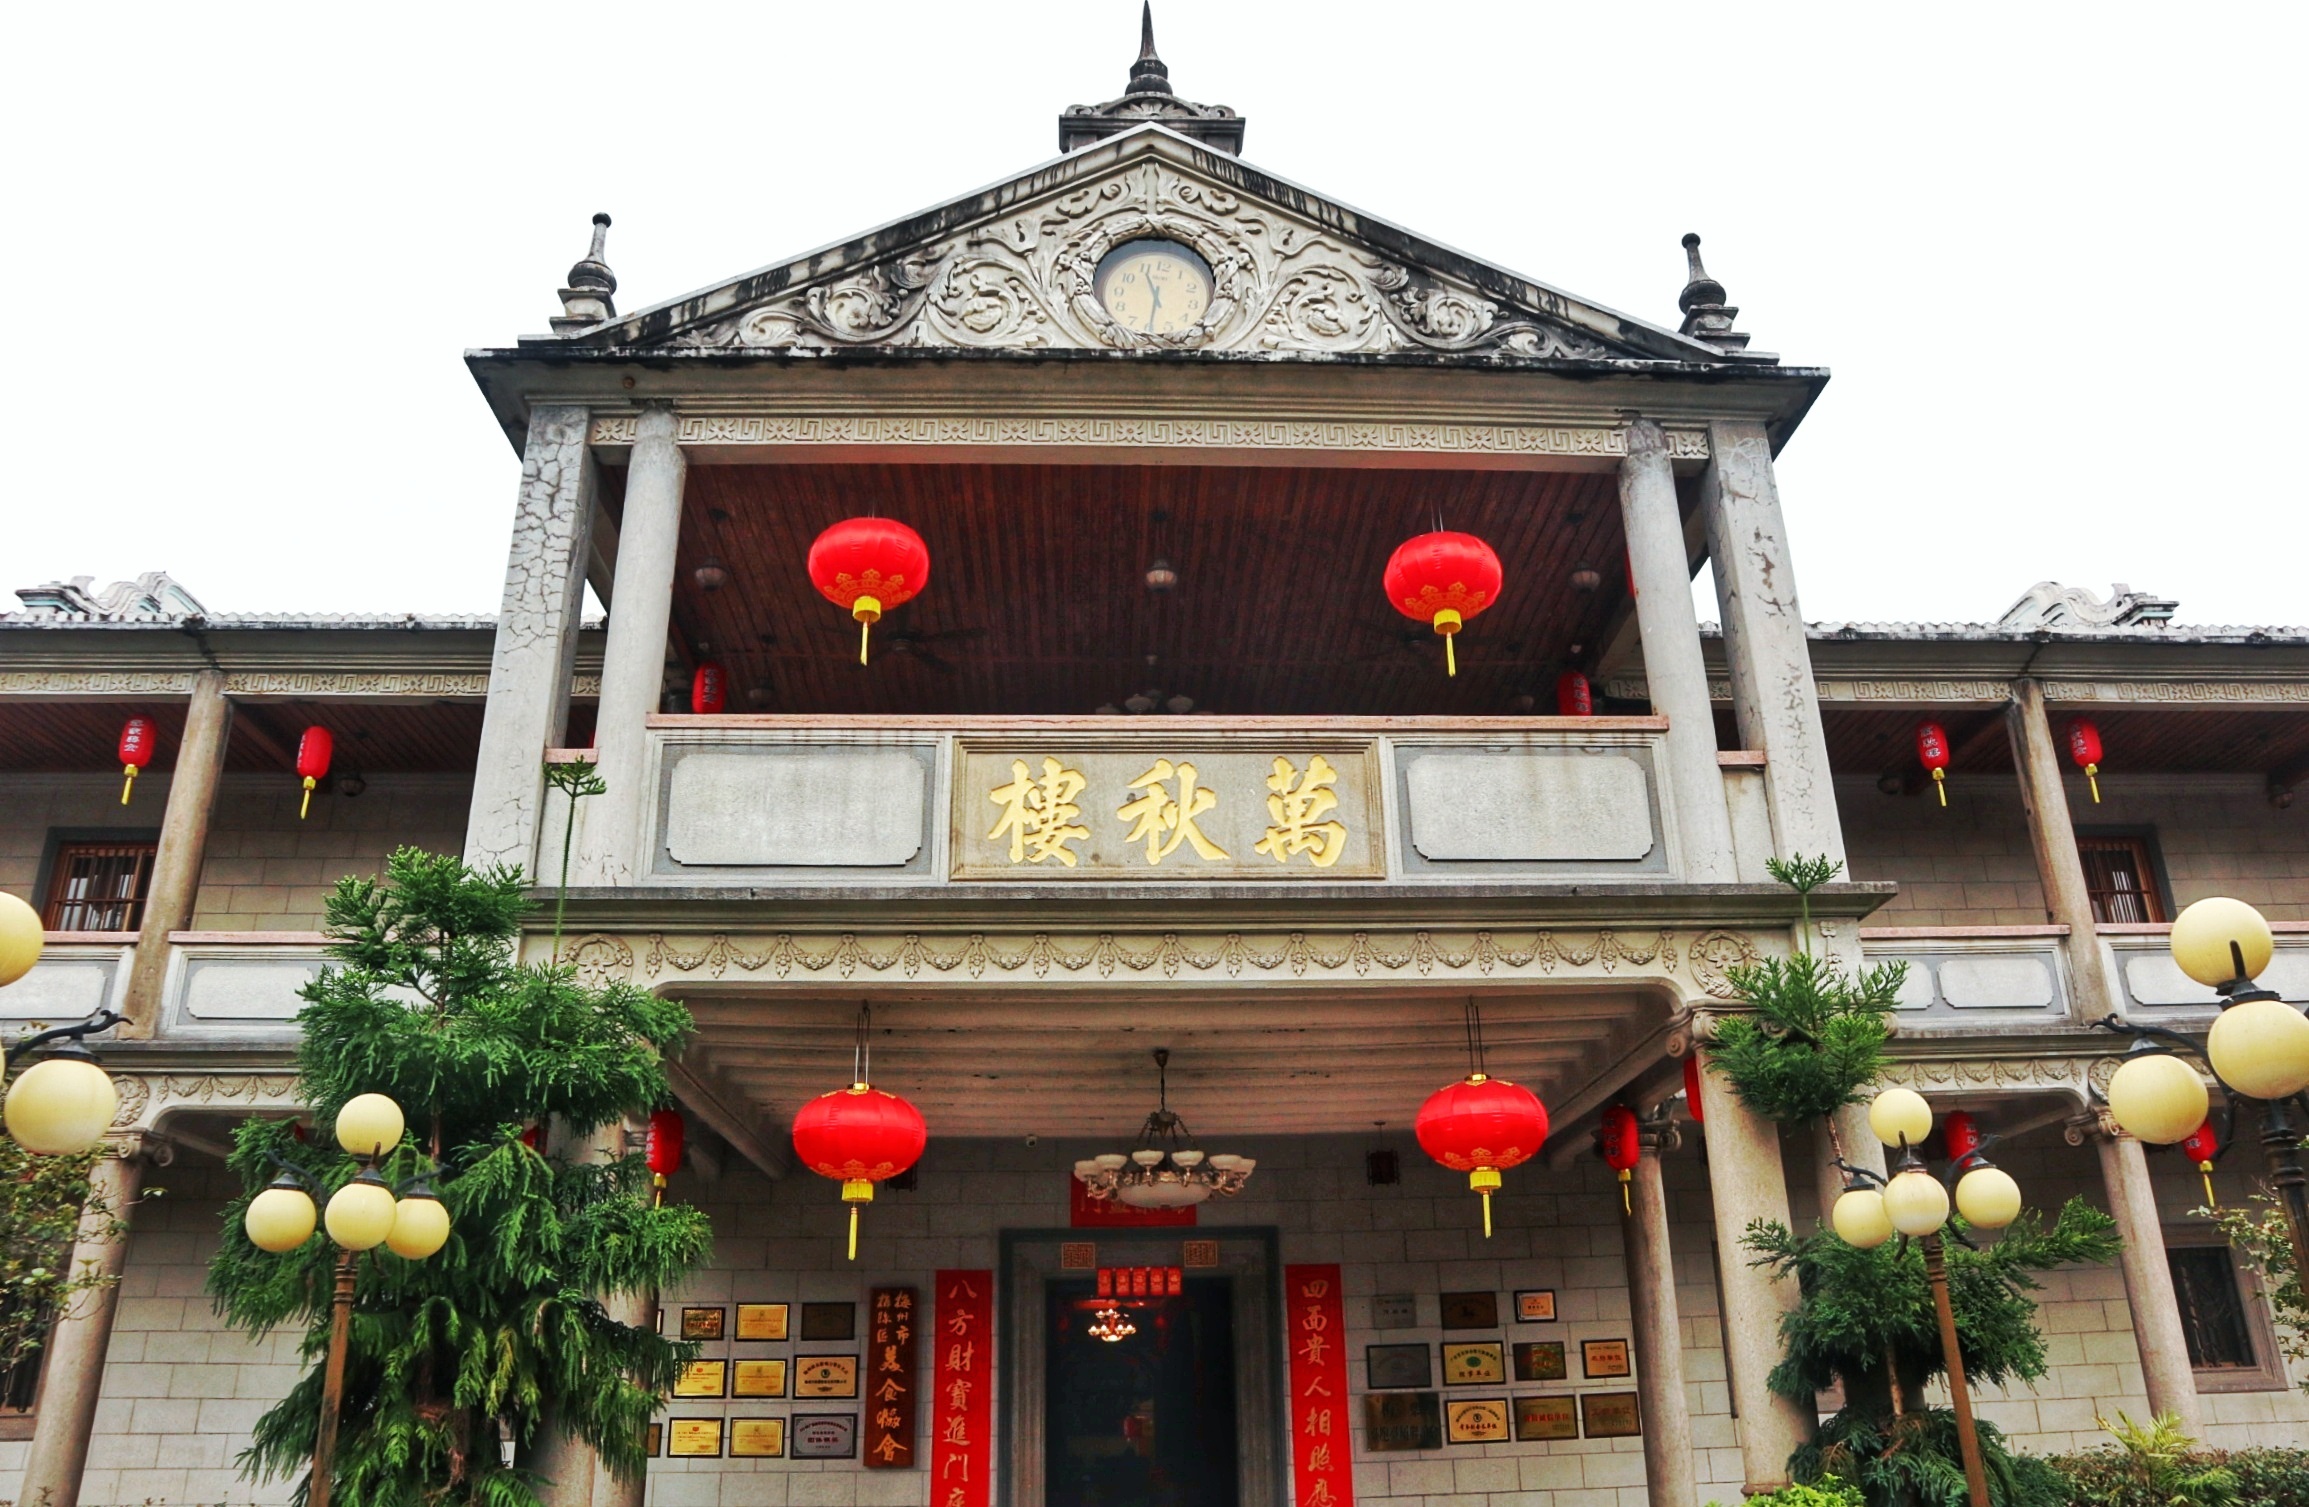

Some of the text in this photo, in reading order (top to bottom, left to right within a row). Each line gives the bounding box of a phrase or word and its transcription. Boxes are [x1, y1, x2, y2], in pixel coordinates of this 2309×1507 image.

[1157, 261, 1171, 272] 12
[1122, 273, 1135, 283] 10
[1177, 271, 1183, 280] 1
[1113, 286, 1124, 297] 9
[1186, 283, 1197, 294] 2
[1115, 301, 1126, 312] 8
[1188, 300, 1198, 311] 3
[1128, 316, 1138, 326] 7
[1179, 313, 1188, 323] 4
[1163, 321, 1173, 331] 5
[987, 754, 1347, 868] 萬秋樓
